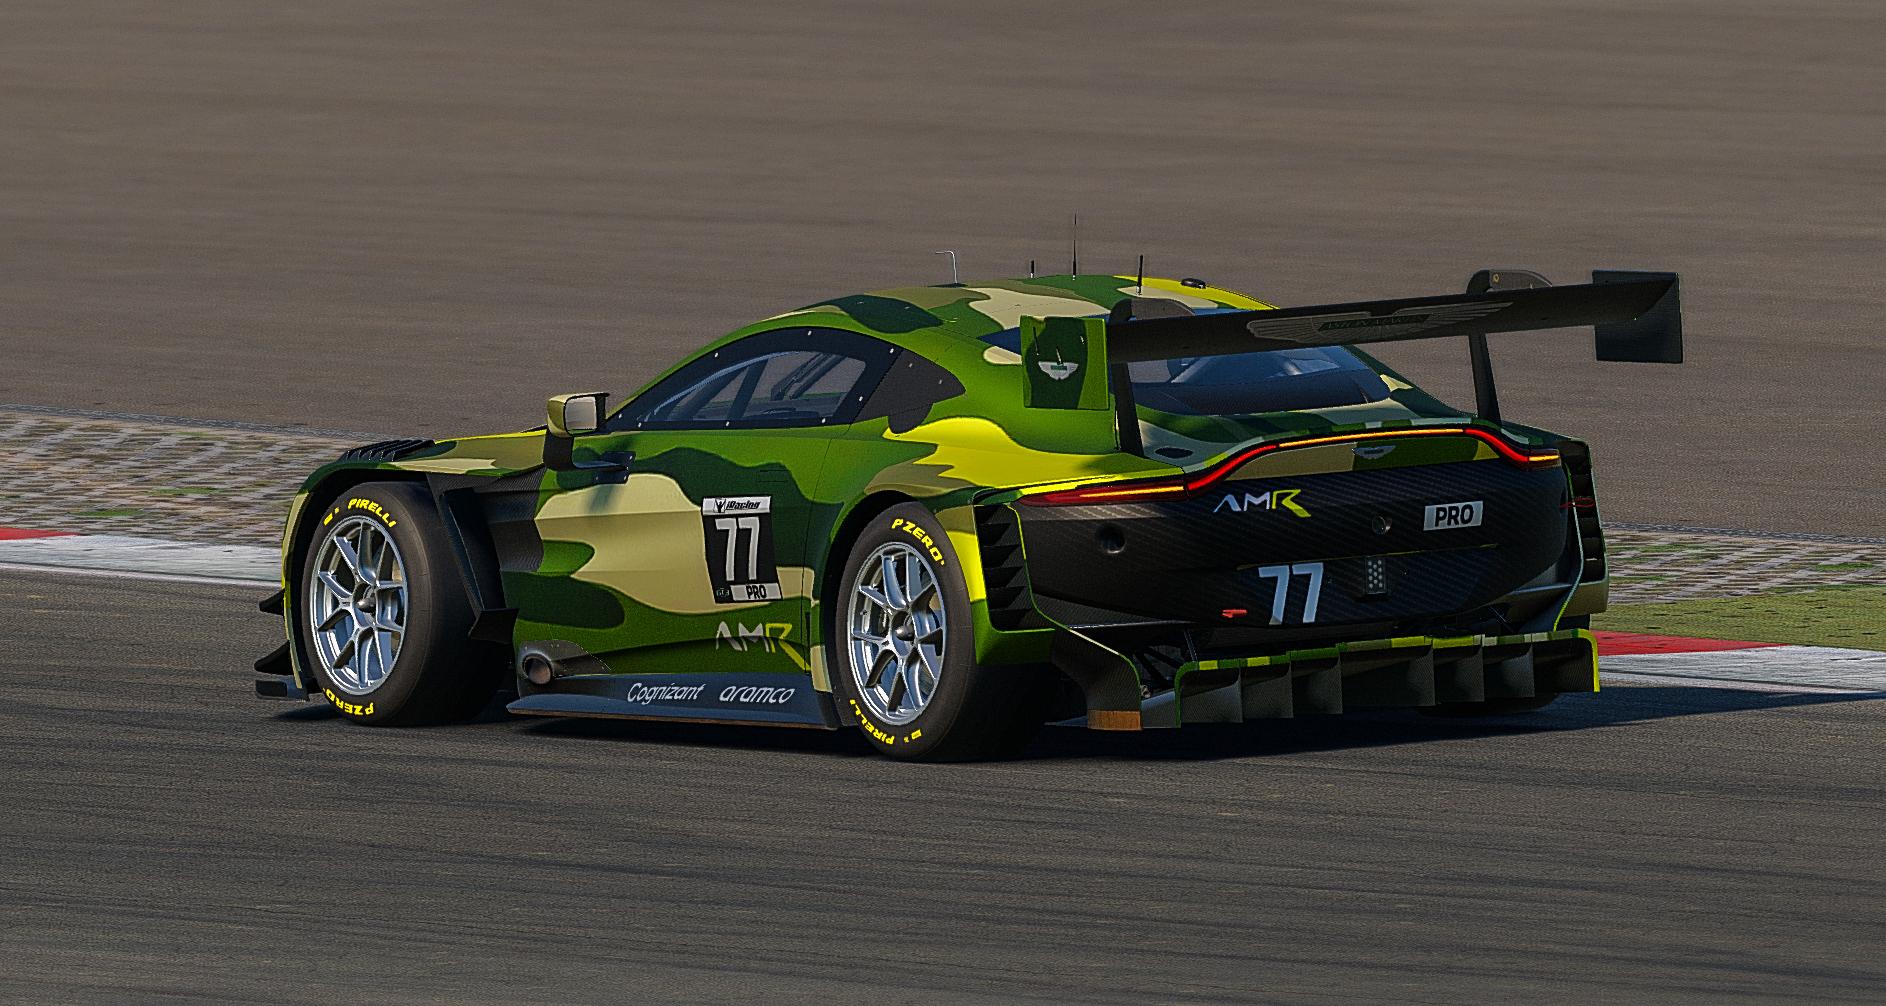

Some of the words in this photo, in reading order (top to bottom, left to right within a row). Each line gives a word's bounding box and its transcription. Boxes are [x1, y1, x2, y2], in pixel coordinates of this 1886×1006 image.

[348, 498, 397, 528] PIRELLI
[726, 500, 761, 511] iRacing
[1213, 489, 1312, 518] AMR
[1434, 504, 1474, 528] PRO
[715, 516, 760, 582] 77
[746, 585, 767, 599] PRO
[1258, 562, 1324, 626] 77
[715, 621, 812, 672] AMR
[627, 683, 706, 705] Cognizant
[719, 686, 795, 704] aramco
[850, 699, 895, 745] PIRELLI
